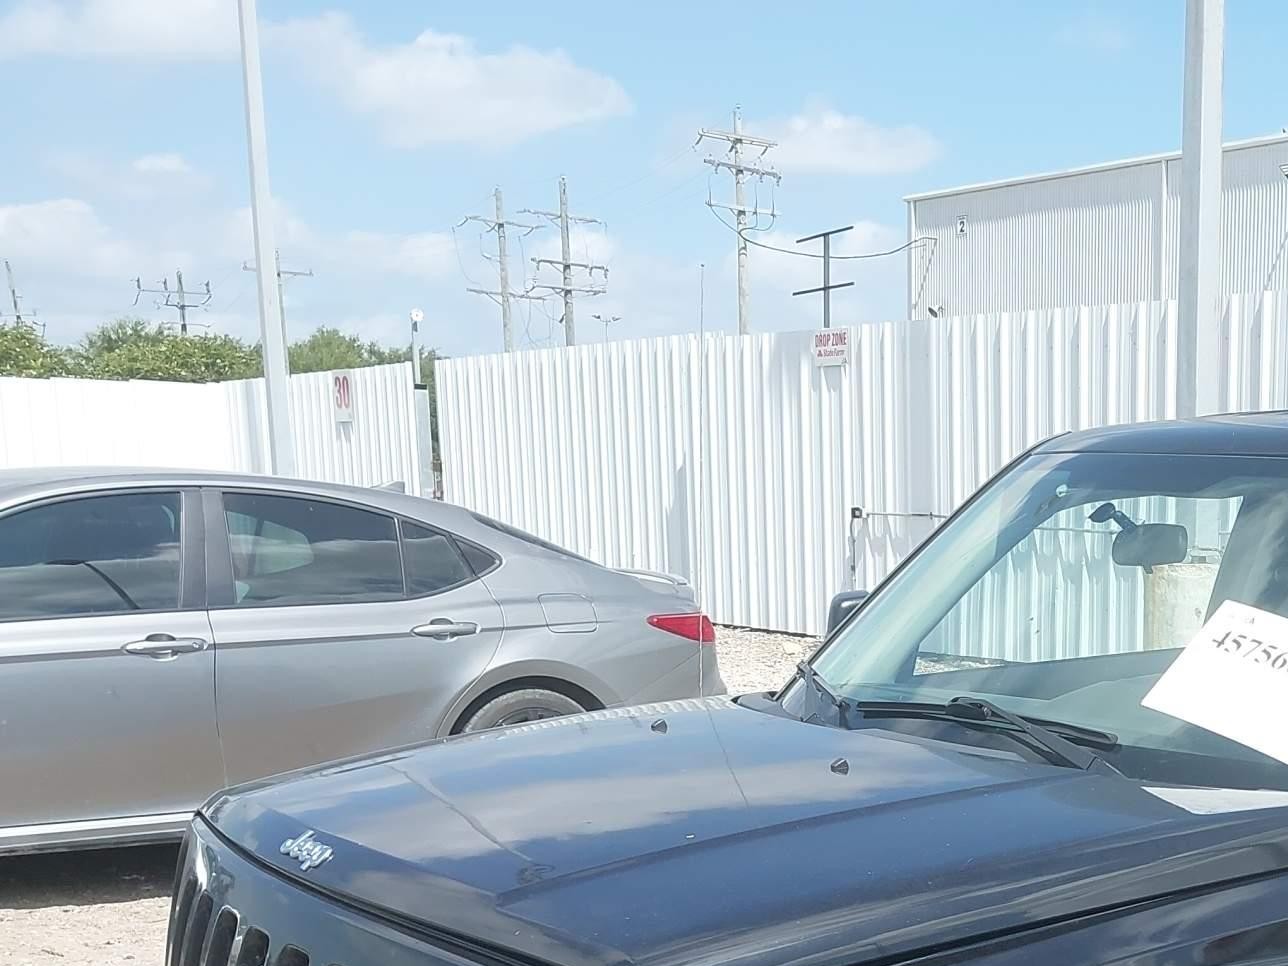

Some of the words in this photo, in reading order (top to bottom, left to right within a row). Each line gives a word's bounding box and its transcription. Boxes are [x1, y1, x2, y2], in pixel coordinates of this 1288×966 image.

[959, 220, 965, 233] 2
[815, 333, 831, 348] DROP
[831, 331, 847, 347] ZONE
[334, 375, 350, 409] 30
[279, 829, 334, 871] Jeep
